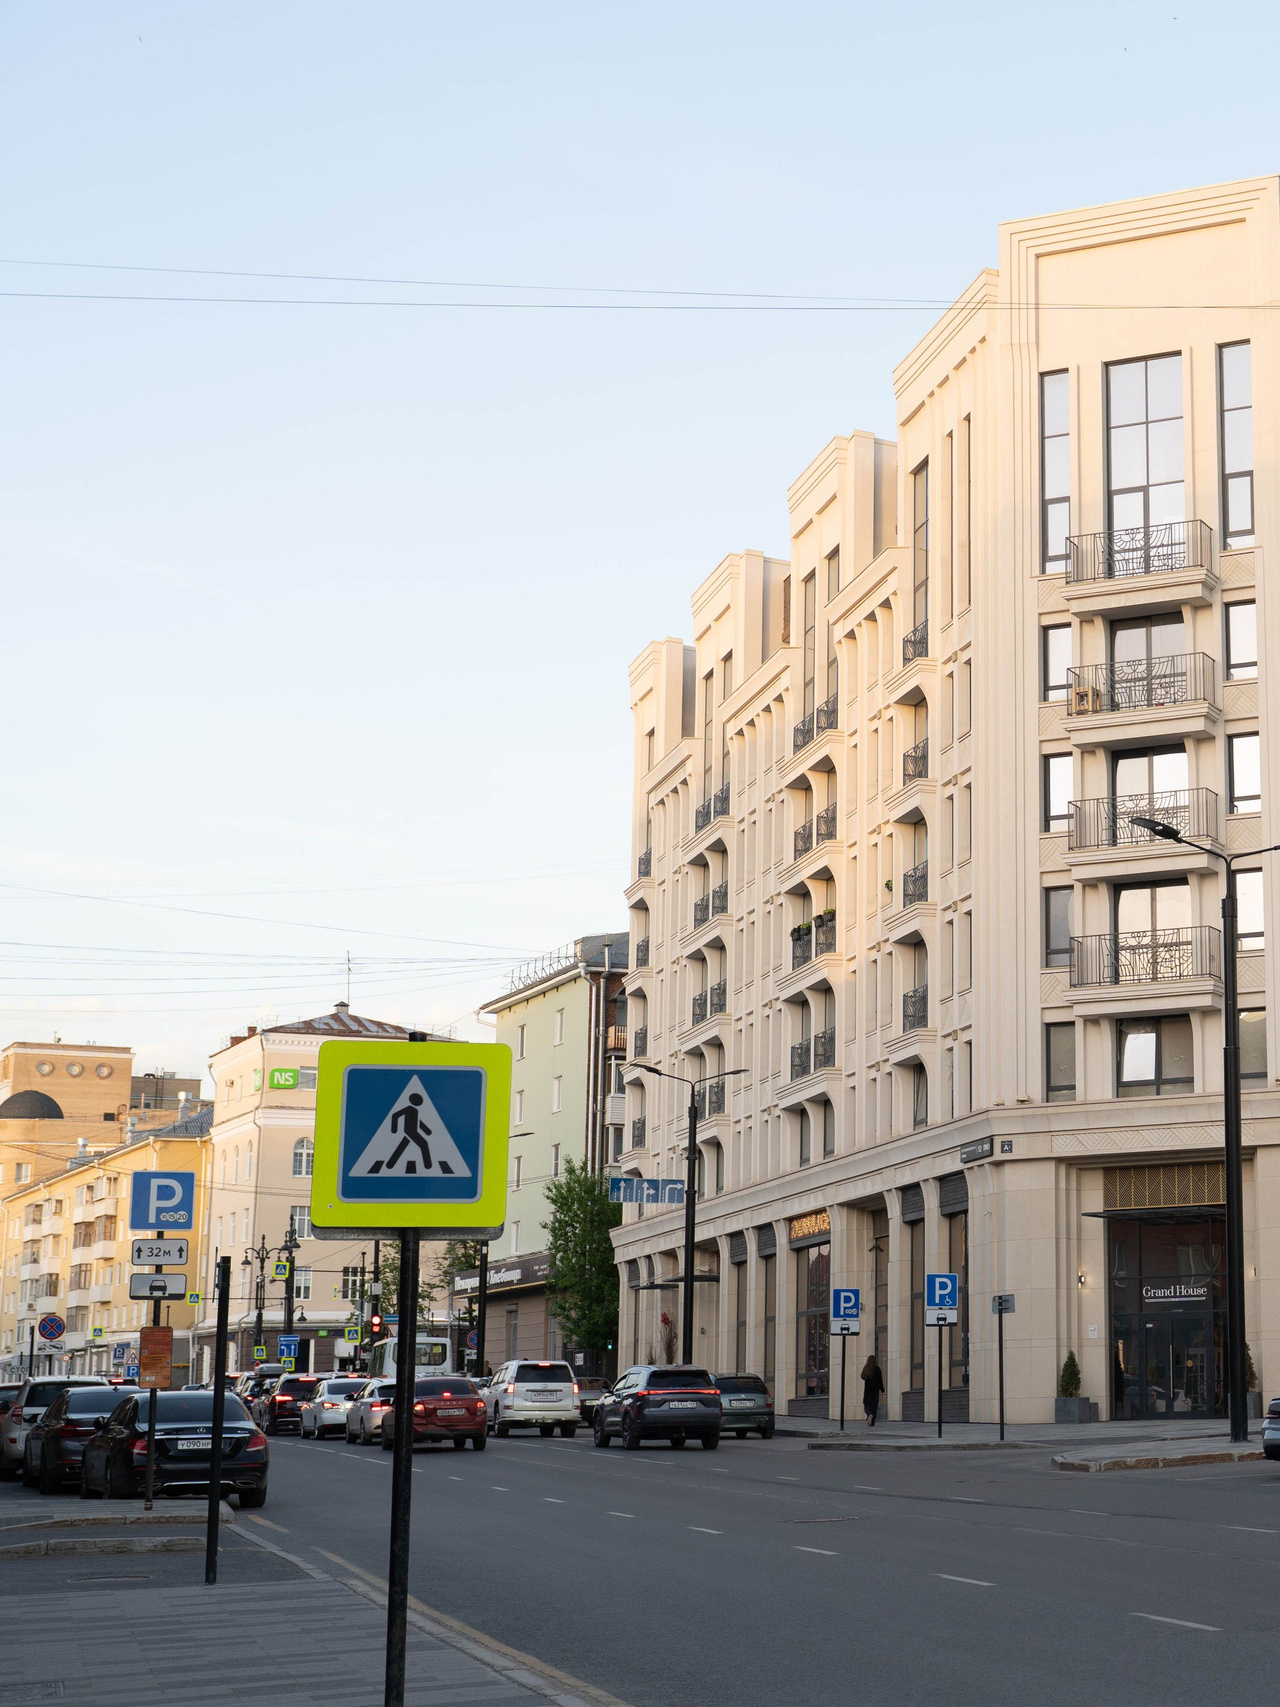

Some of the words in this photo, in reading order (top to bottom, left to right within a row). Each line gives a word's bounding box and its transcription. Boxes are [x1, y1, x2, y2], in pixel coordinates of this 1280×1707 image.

[274, 1072, 294, 1084] NS
[148, 1178, 183, 1224] P
[935, 1278, 952, 1304] P
[1142, 1286, 1174, 1298] Grand
[1176, 1284, 1208, 1296] House
[840, 1292, 856, 1316] P
[130, 1366, 138, 1376] P
